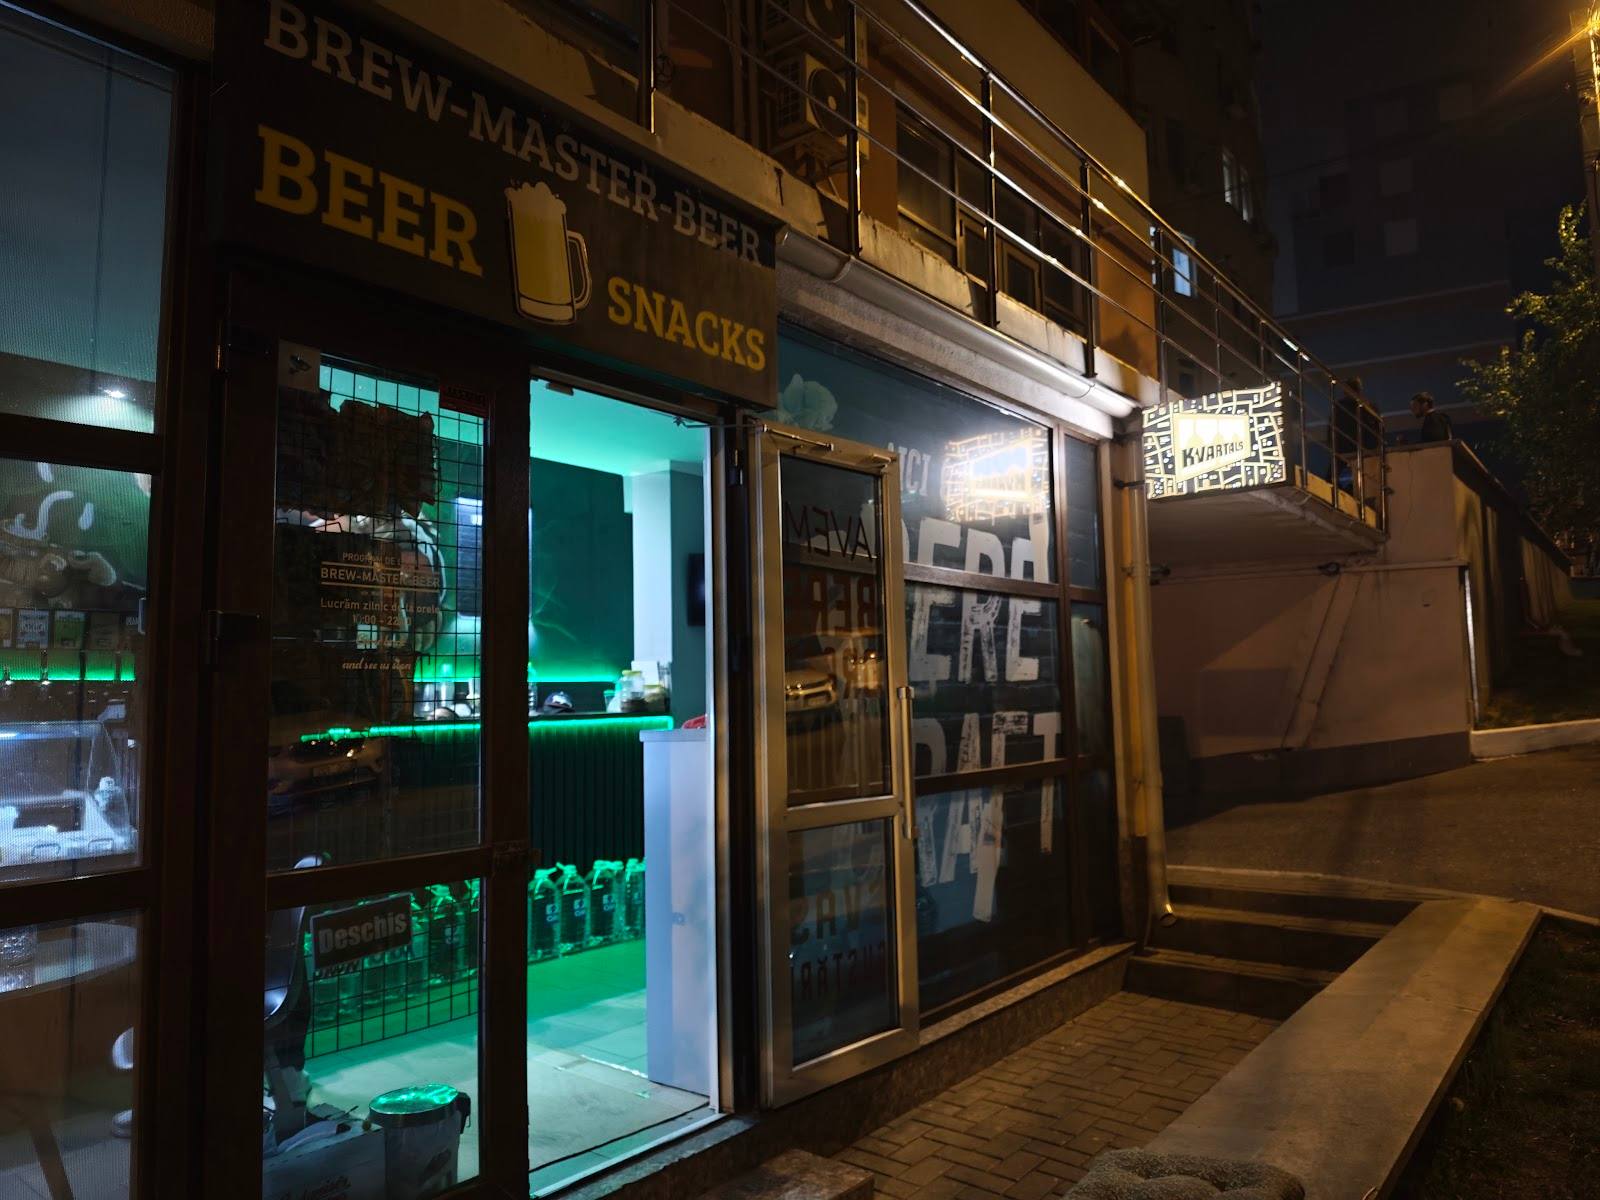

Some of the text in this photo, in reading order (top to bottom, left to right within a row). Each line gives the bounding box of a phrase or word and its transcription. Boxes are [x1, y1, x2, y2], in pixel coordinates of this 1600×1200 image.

[263, 0, 763, 268] BREW-MASTER-BEER
[254, 123, 484, 278] BEER
[606, 276, 767, 372] SNACKS
[315, 910, 409, 954] Deschis
